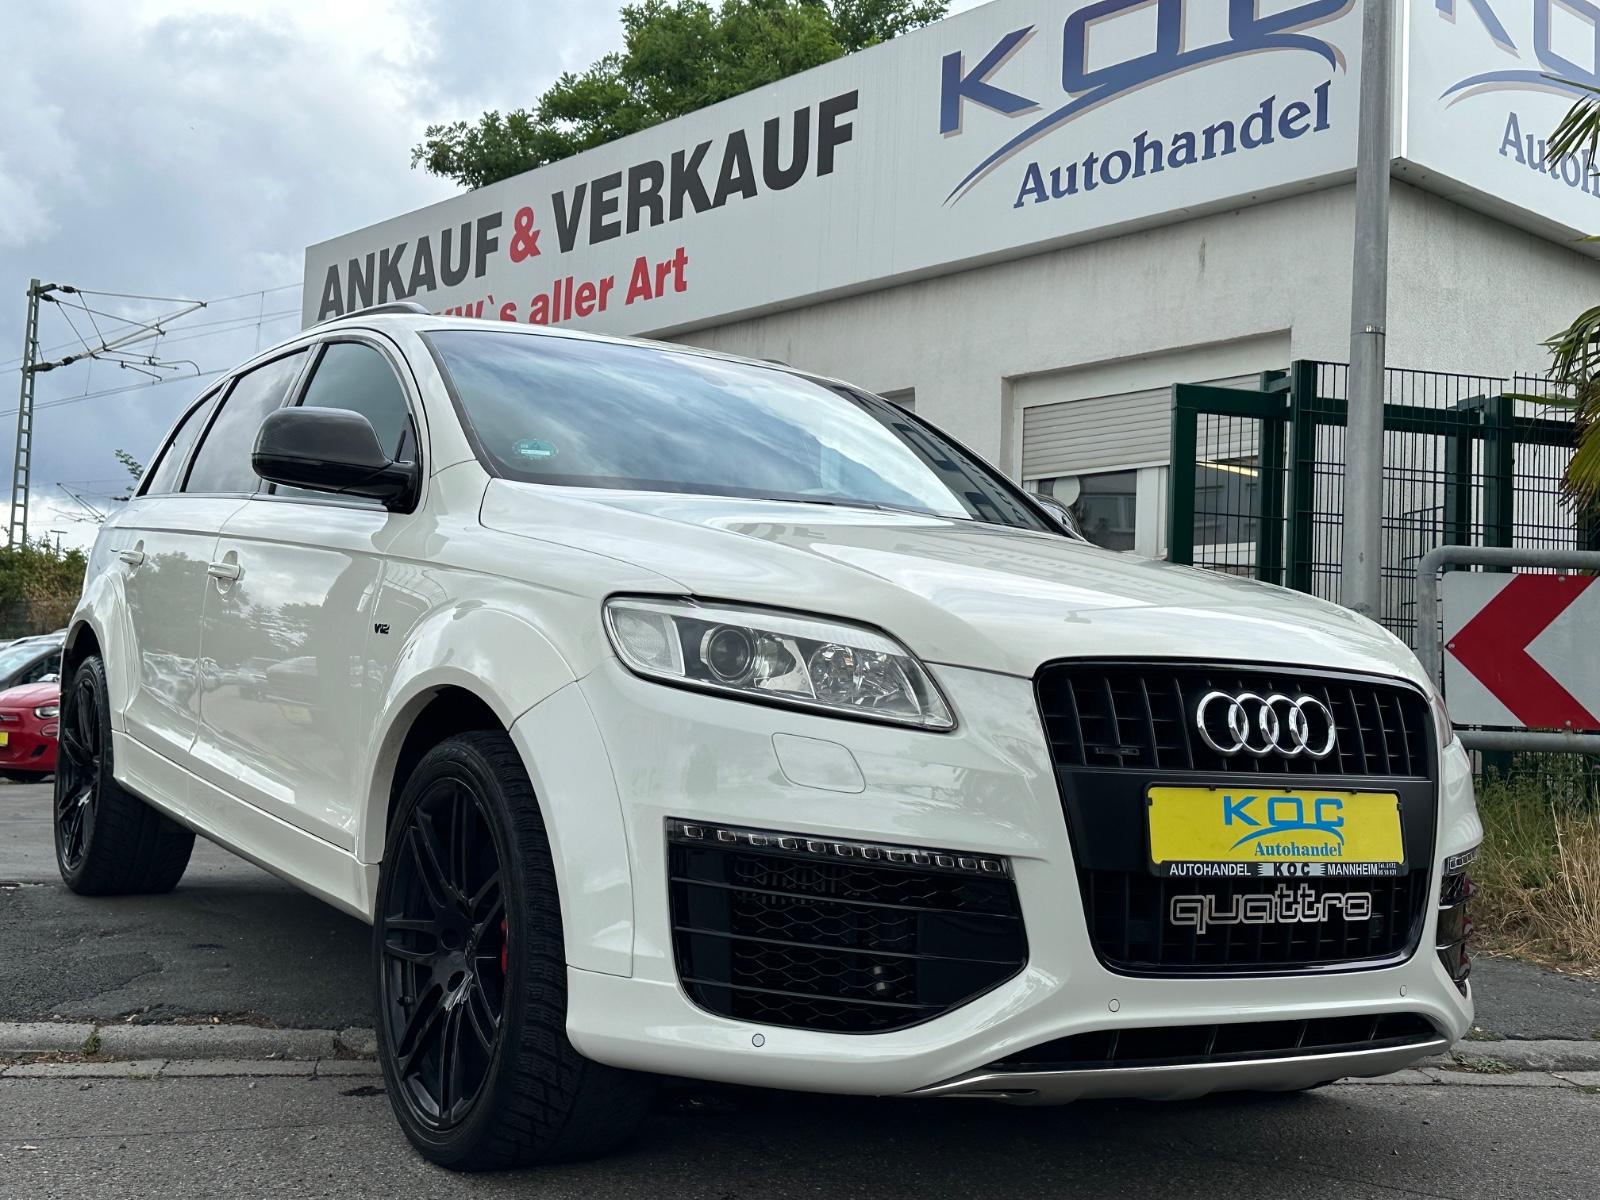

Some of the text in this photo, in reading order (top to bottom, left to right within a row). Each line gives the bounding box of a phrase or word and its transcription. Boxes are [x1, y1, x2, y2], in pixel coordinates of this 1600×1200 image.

[1014, 80, 1332, 208] Autohandel
[318, 89, 859, 321] ANKAUF & VERKAUF
[529, 276, 614, 325] aller
[625, 247, 689, 305] Art
[1223, 795, 1345, 828] KOC
[1169, 863, 1252, 876] AUTOHANDEL
[1327, 863, 1378, 876] MANNHEIM
[1255, 841, 1343, 857] Autohandel
[1170, 883, 1372, 935] quattro
